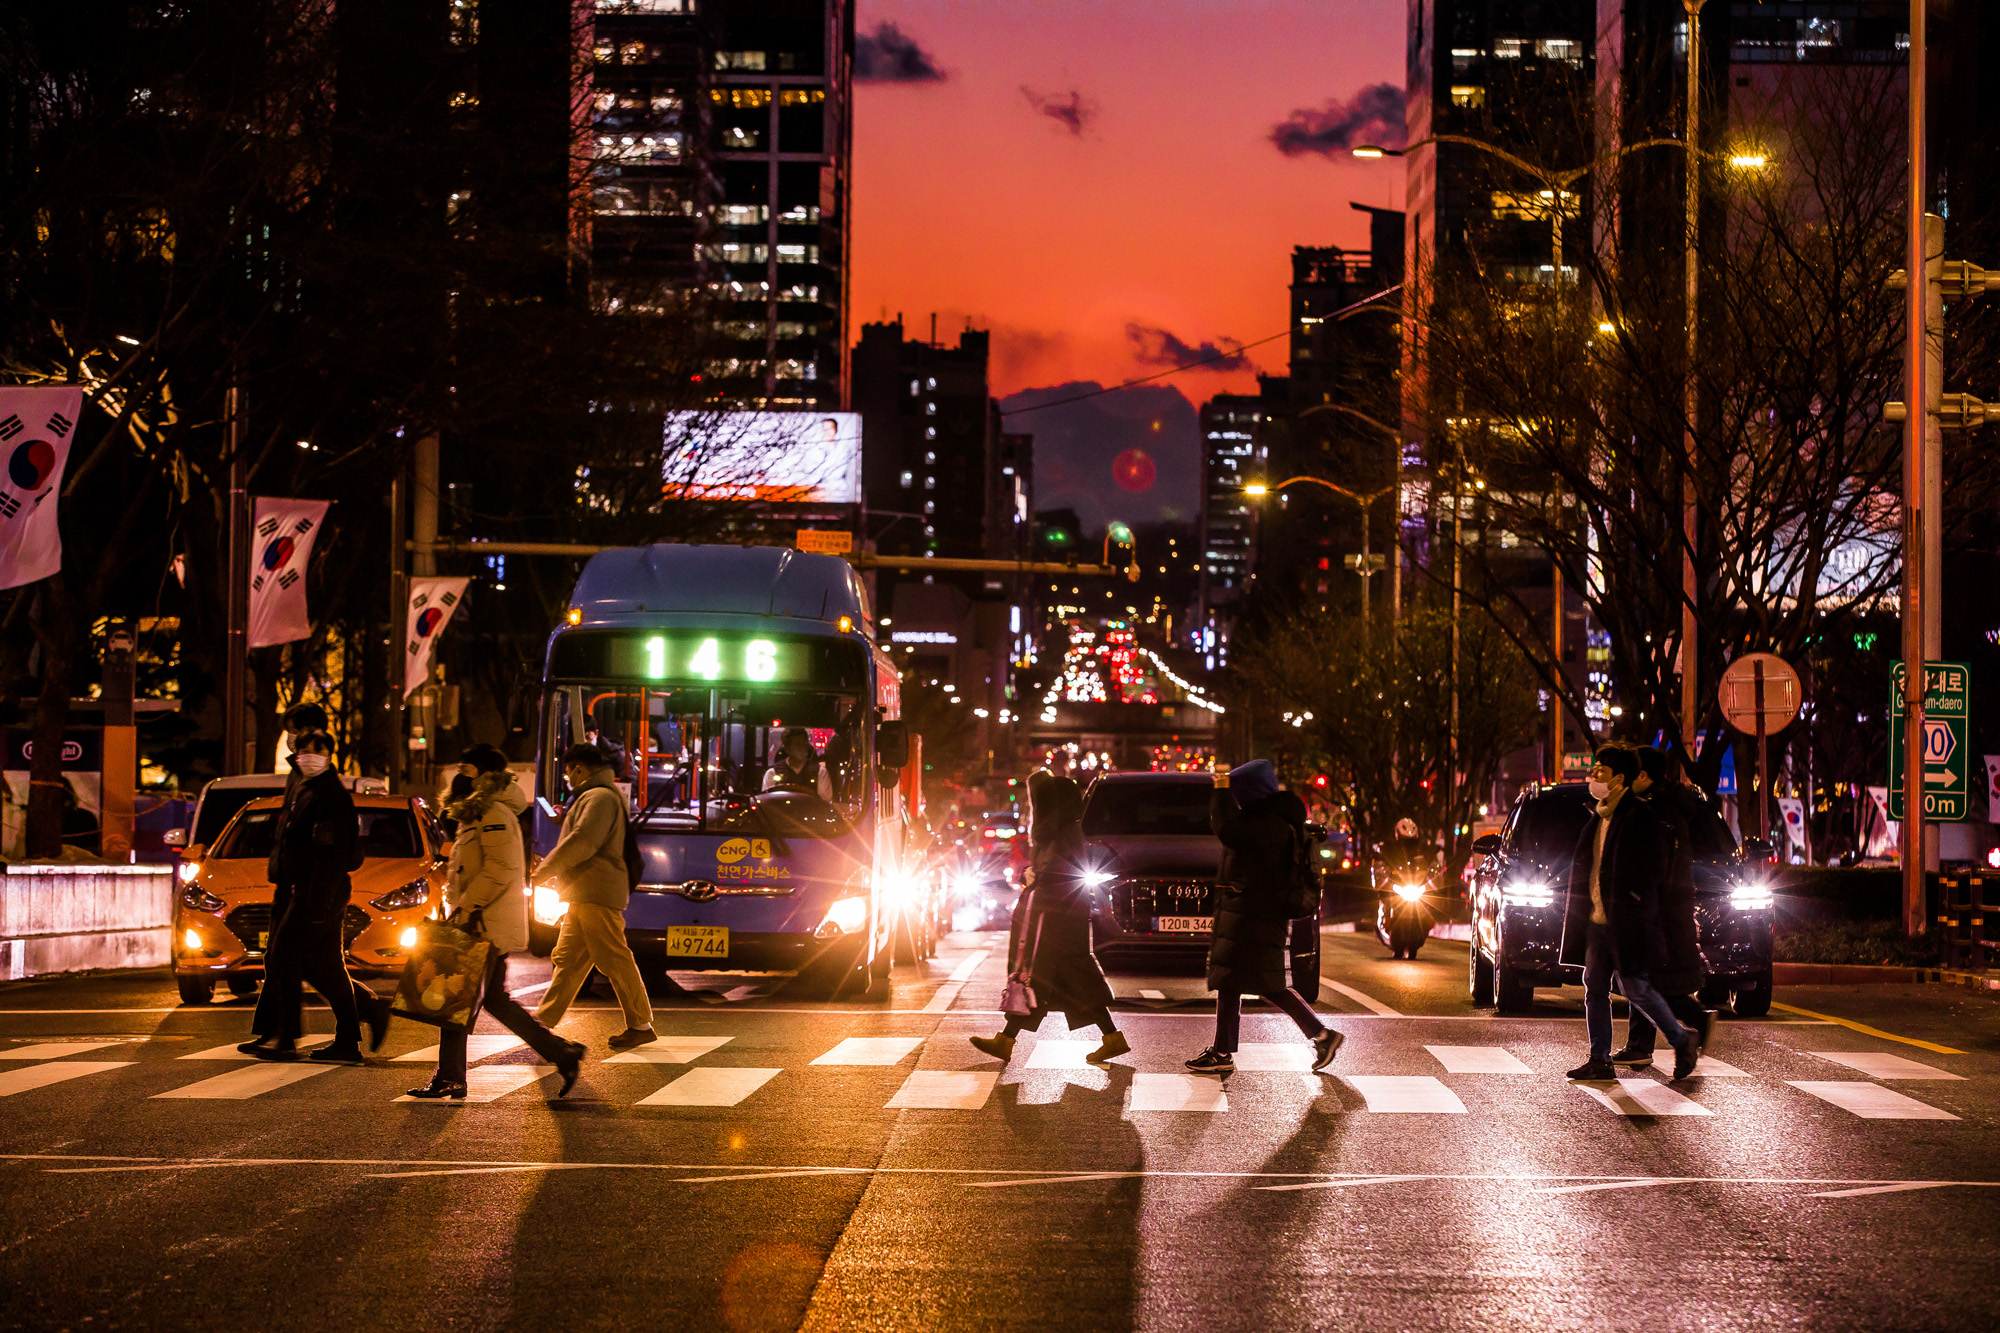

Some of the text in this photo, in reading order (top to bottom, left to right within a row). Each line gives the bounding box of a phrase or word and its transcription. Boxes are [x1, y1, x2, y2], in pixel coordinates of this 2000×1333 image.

[646, 636, 777, 681] 146
[1898, 670, 1963, 693] 대로
[1896, 694, 1962, 710] Gam-daero
[1924, 728, 1945, 757] 0
[719, 846, 747, 856] CNG
[716, 865, 791, 880] 천연가스버스
[1193, 918, 1214, 930] 344
[683, 938, 725, 954] 9744
